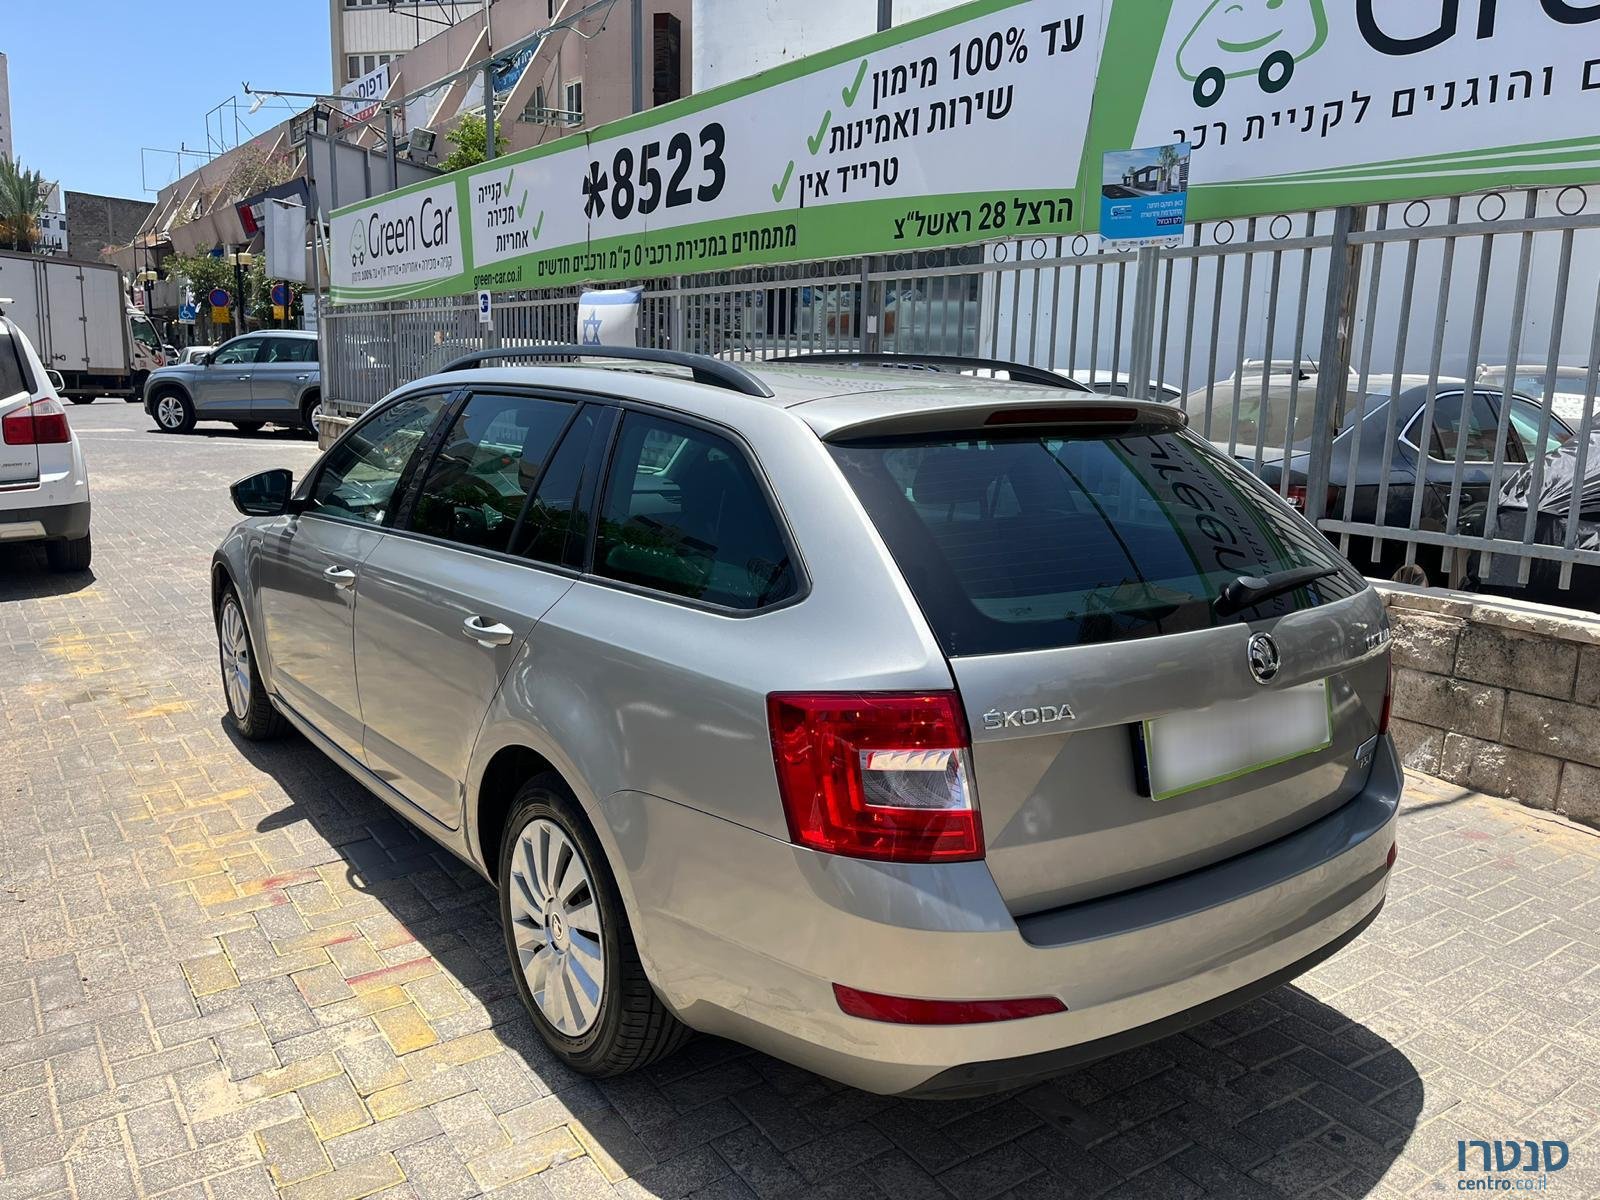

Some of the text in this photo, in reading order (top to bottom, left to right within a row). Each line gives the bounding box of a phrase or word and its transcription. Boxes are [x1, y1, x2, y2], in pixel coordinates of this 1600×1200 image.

[872, 14, 1085, 109] עד 100% מימון
[1391, 65, 1554, 118] והוגנים
[829, 84, 1014, 154] שירות ואמינות
[1242, 90, 1372, 142] לקניית
[478, 181, 502, 205] קנייה
[799, 156, 899, 208] טרייד אין
[487, 205, 515, 228] מכירה
[978, 201, 1007, 231] 28
[1013, 197, 1073, 227] הרצל
[368, 197, 453, 259] Green Car
[496, 230, 529, 253] אחריות
[732, 224, 797, 254] מתמחים
[572, 251, 606, 273] ורכבים
[634, 244, 642, 266] 0
[645, 244, 672, 266] רכבי
[675, 235, 727, 262] במכירת
[474, 265, 522, 290] green-car.co.il
[538, 254, 570, 277] חדשים
